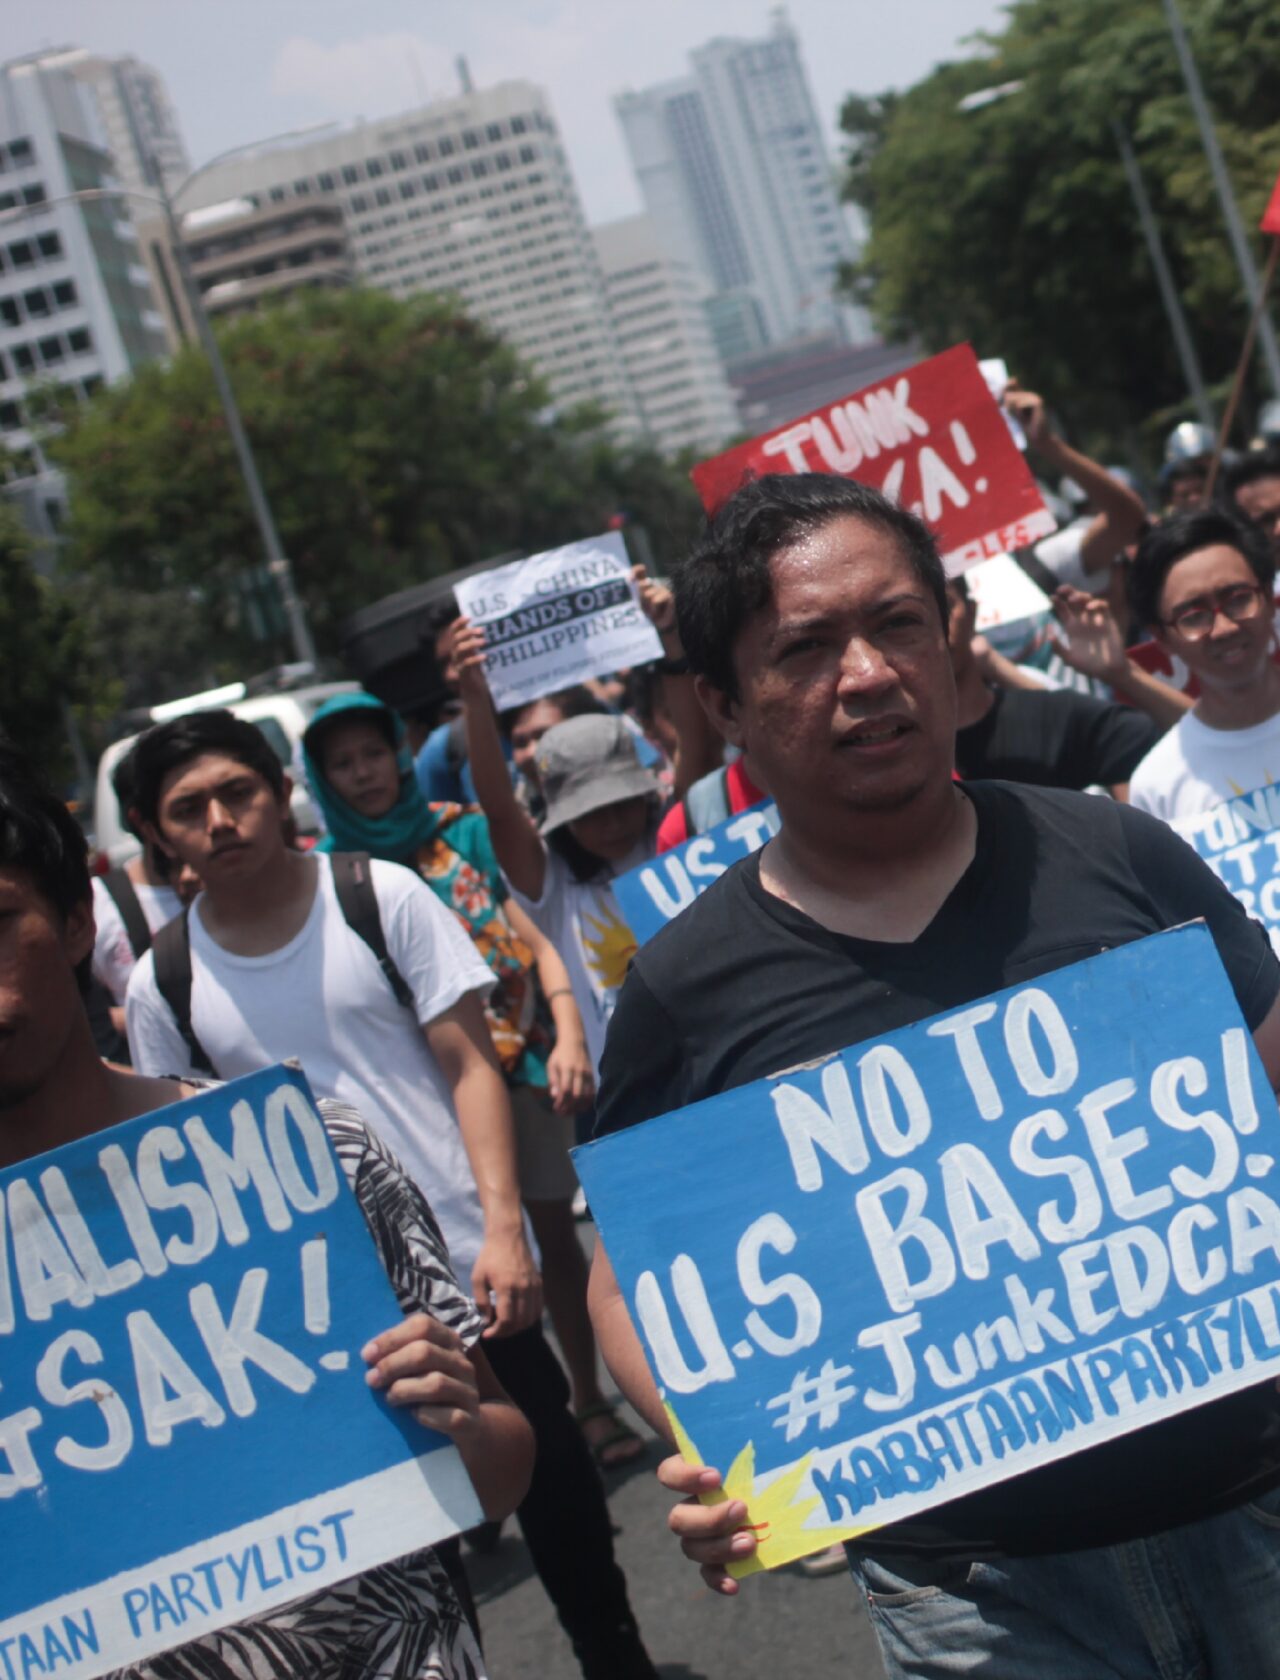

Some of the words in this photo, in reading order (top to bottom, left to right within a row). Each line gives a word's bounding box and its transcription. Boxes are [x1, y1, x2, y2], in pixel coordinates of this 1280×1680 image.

[482, 599, 572, 644] HANDS
[575, 581, 626, 612] OFF
[484, 605, 640, 673] PHILIPPINES
[771, 1044, 932, 1193] NO
[927, 987, 1079, 1121] TO
[635, 1212, 823, 1396] U.S
[855, 1027, 1275, 1313] BASES!
[122, 1509, 355, 1639] PARTYLIST
